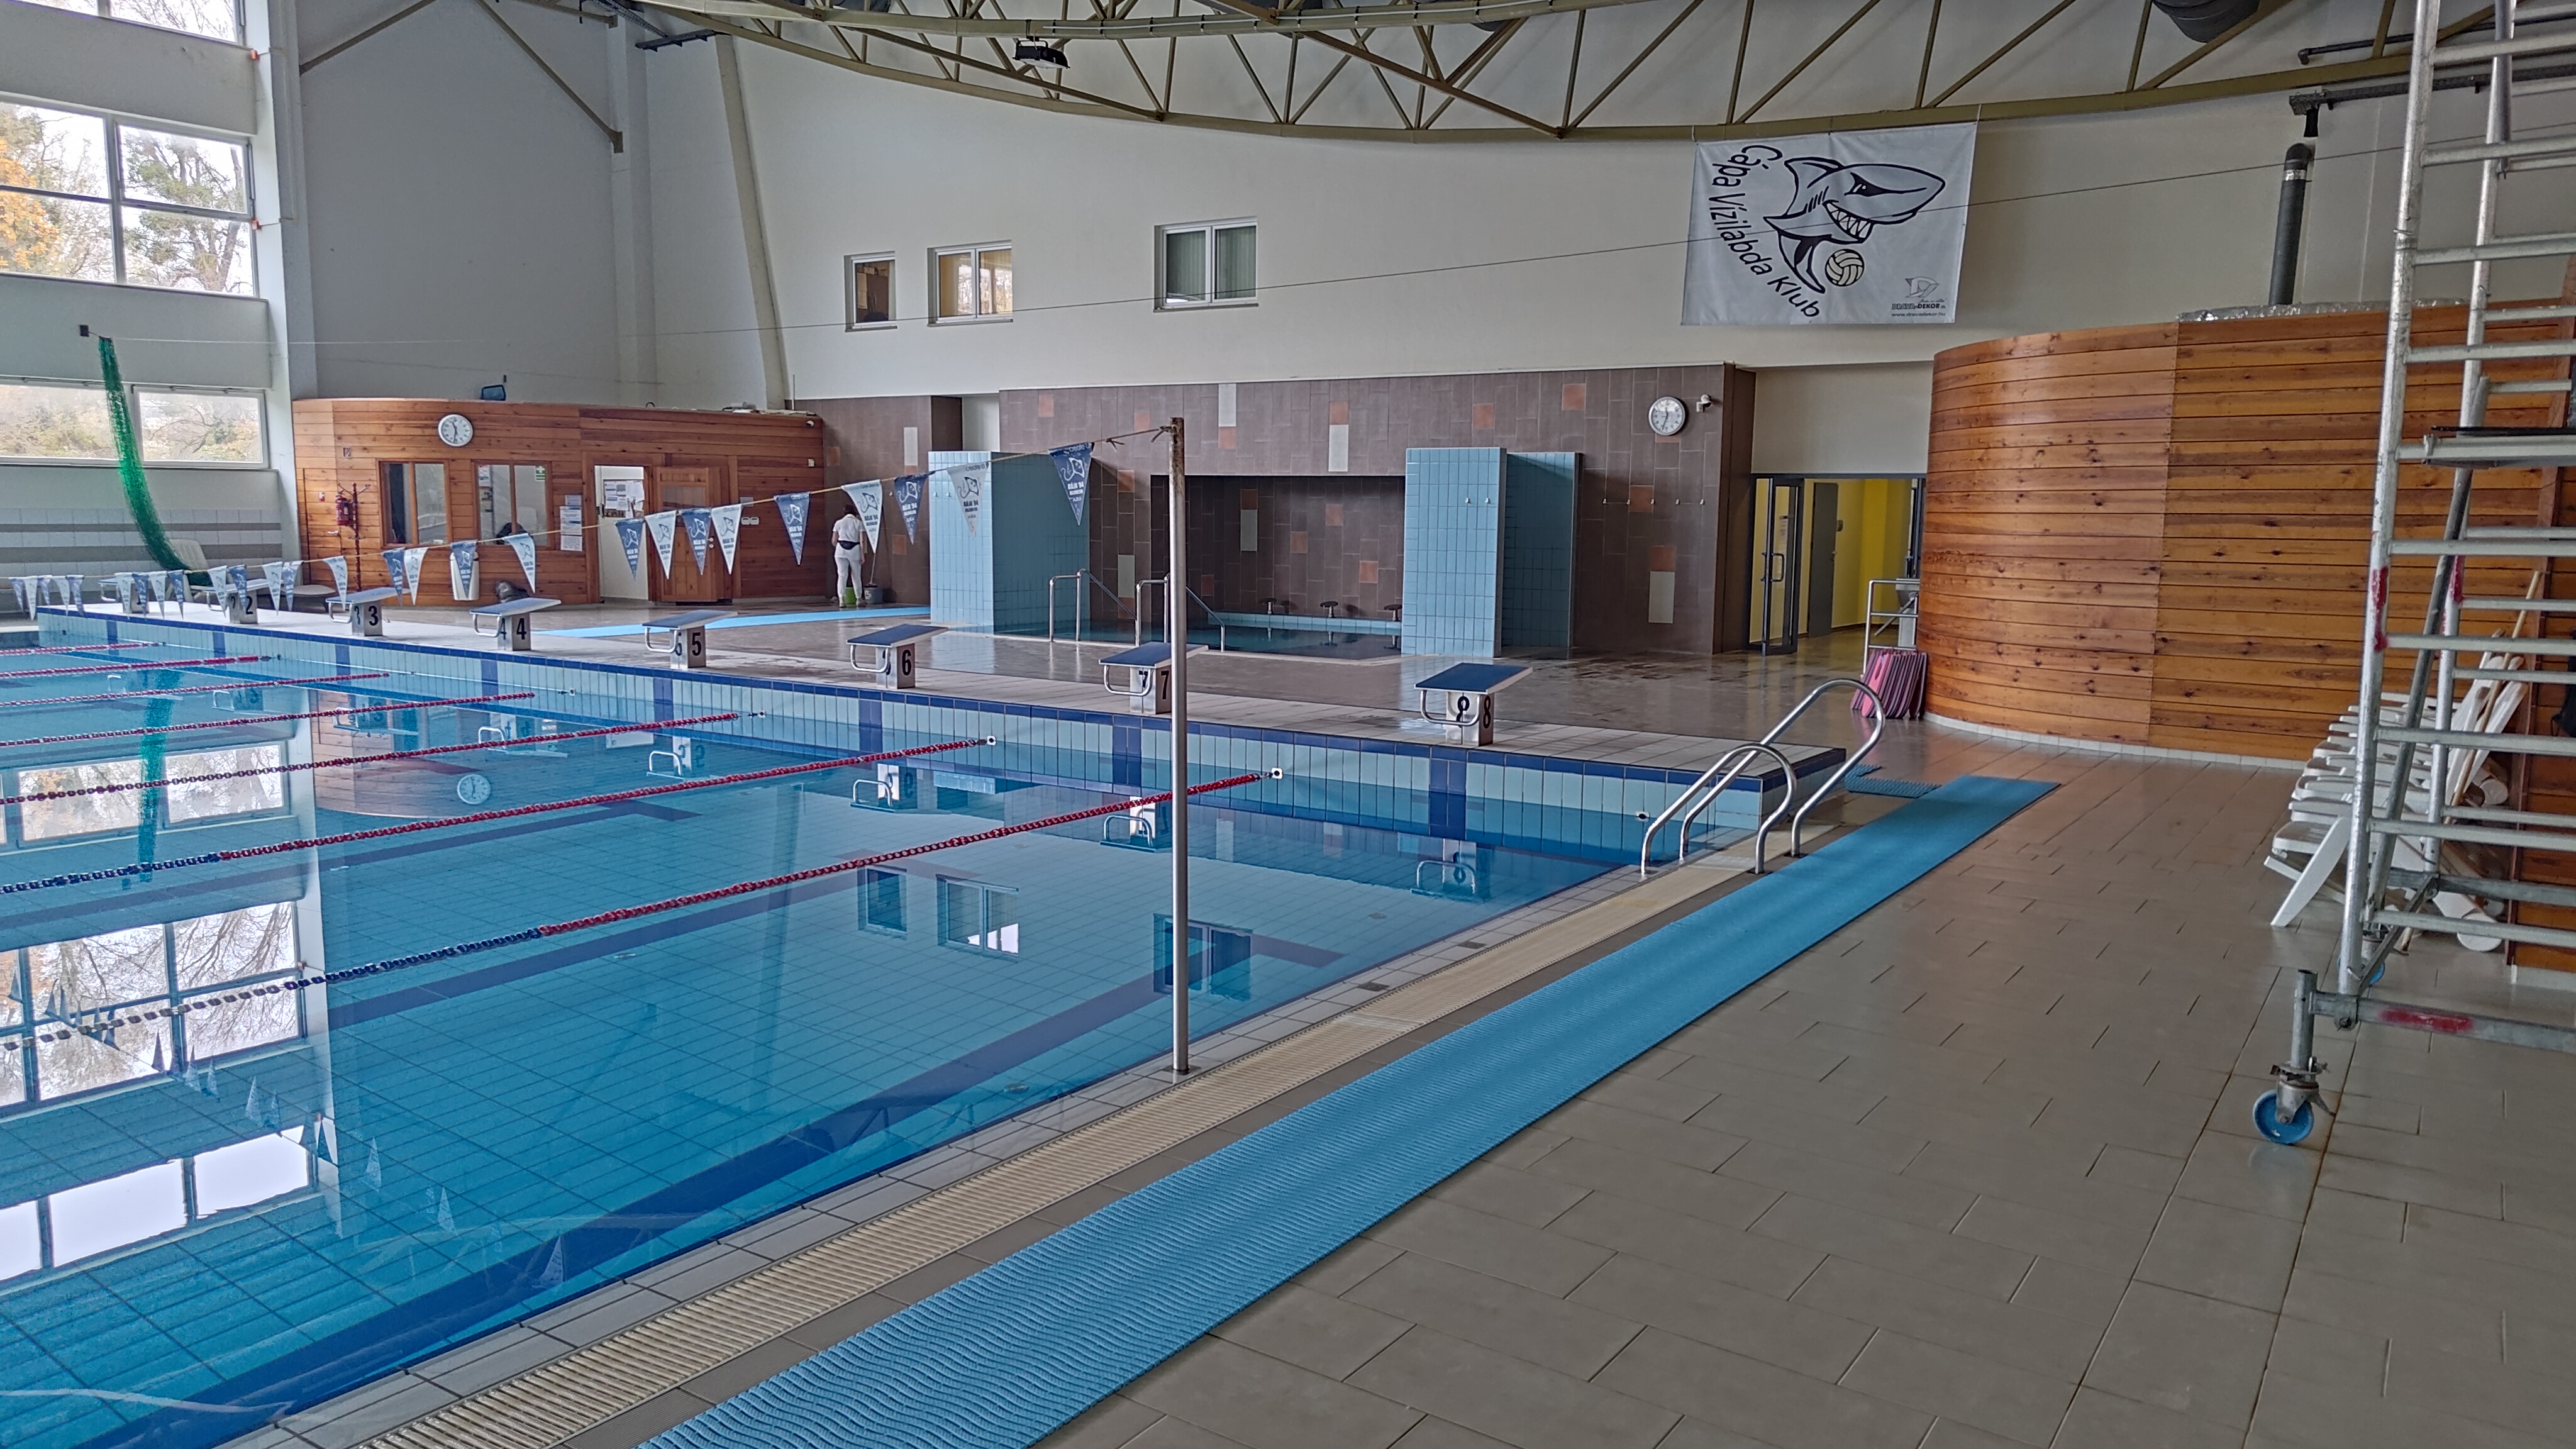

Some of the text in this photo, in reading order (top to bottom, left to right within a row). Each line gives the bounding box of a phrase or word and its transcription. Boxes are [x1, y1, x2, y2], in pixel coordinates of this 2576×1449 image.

[1709, 145, 1820, 318] Cápa Vízilabda Klub
[246, 596, 253, 614] 2
[369, 605, 379, 626] 3
[516, 618, 527, 640] 4
[692, 632, 702, 656] 5
[902, 649, 912, 676] 6
[1160, 670, 1169, 700] 7
[1483, 695, 1491, 730] 8
